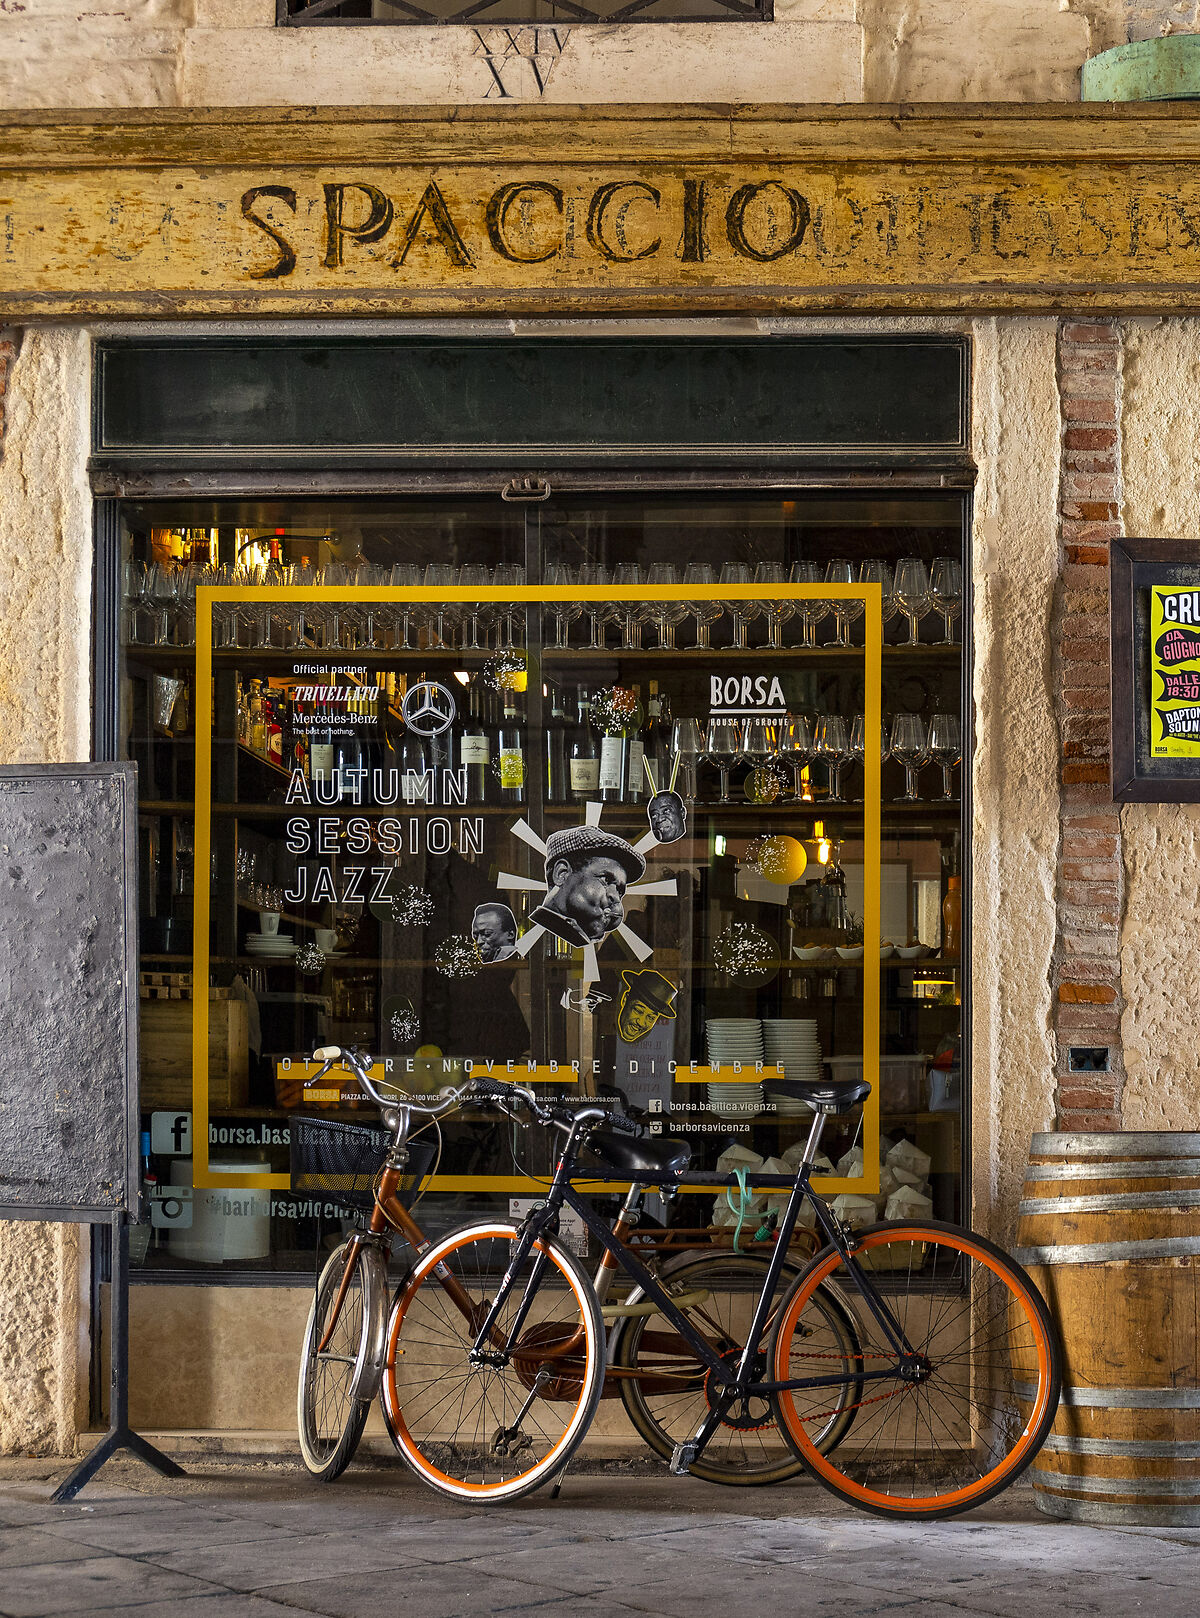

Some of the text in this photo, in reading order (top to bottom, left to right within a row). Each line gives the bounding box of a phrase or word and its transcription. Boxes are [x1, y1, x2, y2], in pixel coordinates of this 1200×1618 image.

[472, 28, 572, 55] XXIV
[482, 56, 555, 98] XV
[241, 178, 810, 280] SPACCIO
[1166, 631, 1184, 641] DA
[1163, 642, 1200, 660] GIUGNO
[293, 664, 367, 677] Official partner
[1166, 674, 1200, 686] DALLE
[294, 686, 379, 702] TRIVELLATO
[710, 675, 786, 706] BORSA
[1167, 686, 1199, 698] 18:30
[292, 712, 378, 724] Mercedes-Benz
[710, 717, 788, 726] HOUSE OF GROOVE
[330, 728, 355, 737] nothing.
[285, 769, 467, 805] AUTUMN
[286, 818, 484, 854] SESSION
[284, 867, 394, 903] JAZZ
[282, 1057, 785, 1074] OTORE NOVEMBRE DICEMBRE
[565, 1094, 621, 1103] www.barborsa.com
[669, 1102, 777, 1112] borsa.basilica.vicenza
[669, 1122, 750, 1132] barborsavicenza
